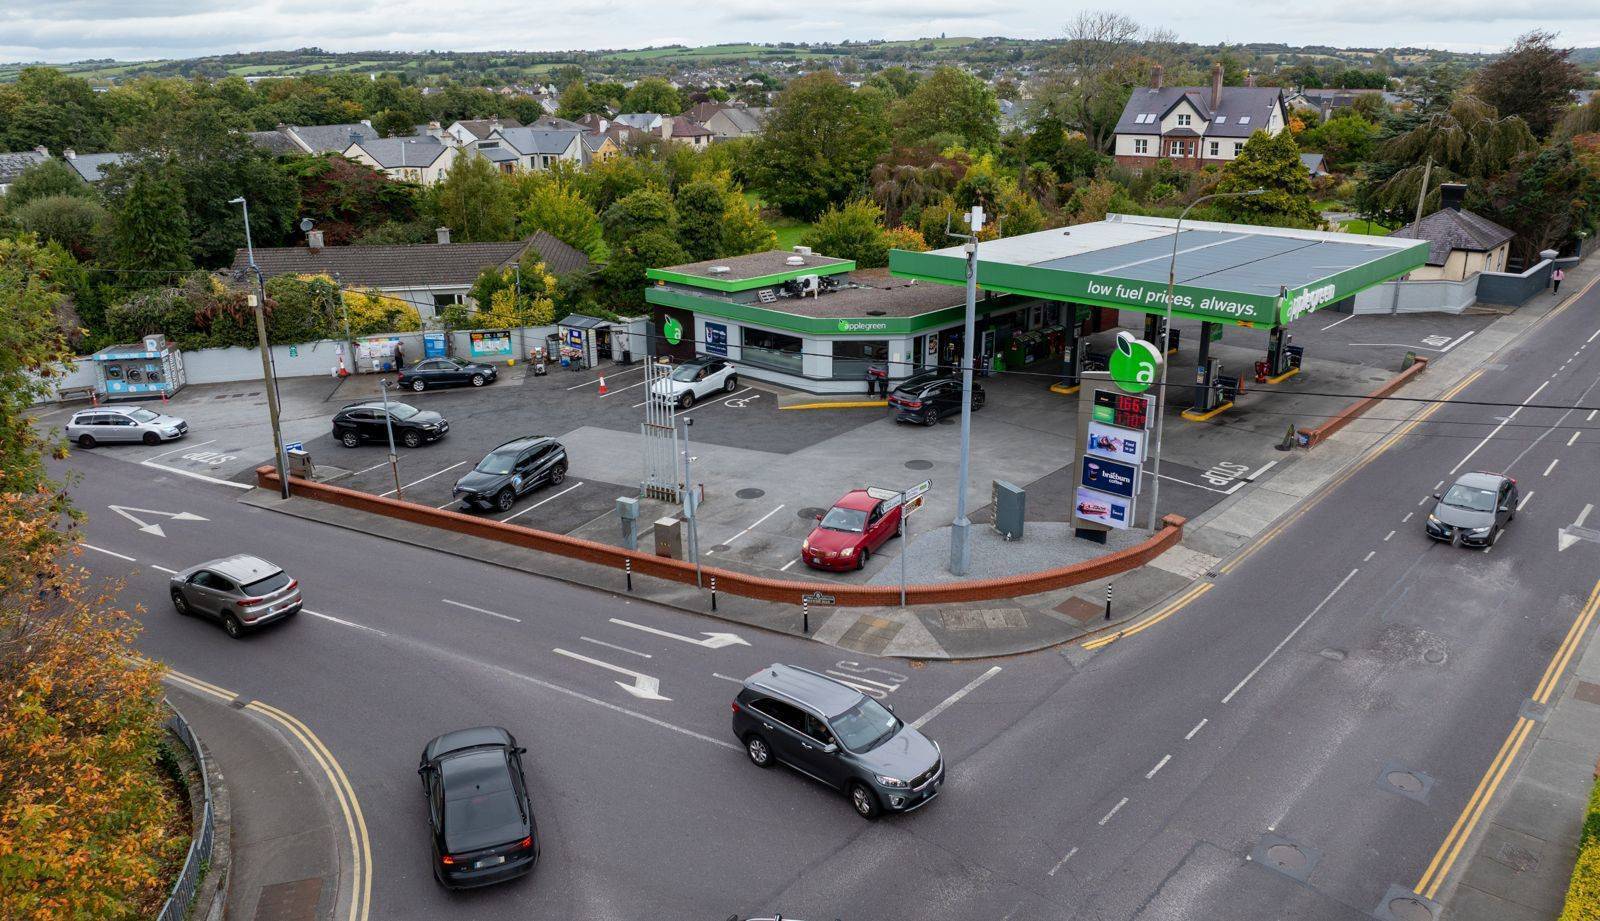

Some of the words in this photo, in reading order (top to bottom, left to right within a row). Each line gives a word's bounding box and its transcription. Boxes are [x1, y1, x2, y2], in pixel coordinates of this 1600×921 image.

[1087, 280, 1110, 296] low
[1115, 283, 1142, 301] fuel
[1146, 289, 1195, 309] prices,
[1200, 296, 1258, 317] always.
[1286, 284, 1336, 322] applegreen
[844, 321, 887, 331] applegreen
[1136, 361, 1154, 385] a
[1200, 461, 1250, 486] STOP
